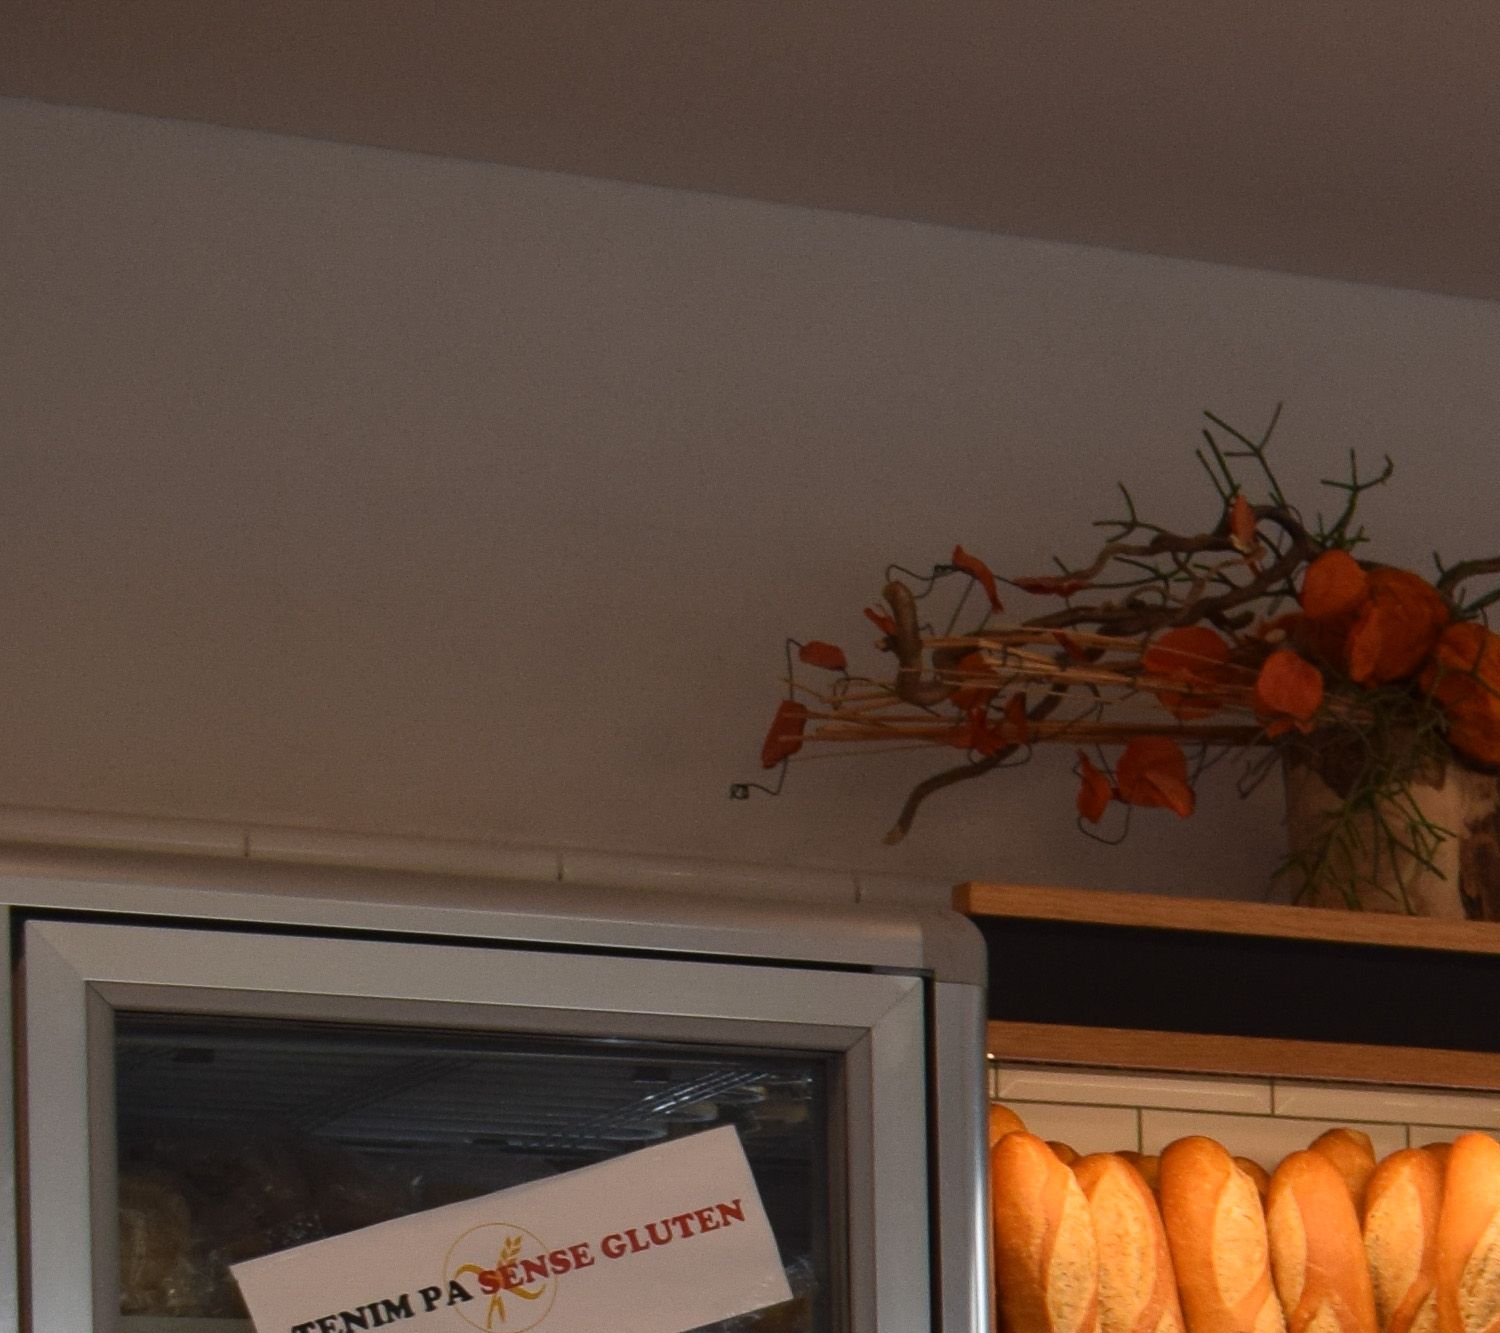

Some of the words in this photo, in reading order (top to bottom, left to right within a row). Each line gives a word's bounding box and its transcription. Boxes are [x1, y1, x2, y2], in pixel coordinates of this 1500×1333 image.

[421, 1277, 474, 1316] PA
[475, 1242, 596, 1295] SENSE
[600, 1198, 747, 1261] GLUTEN
